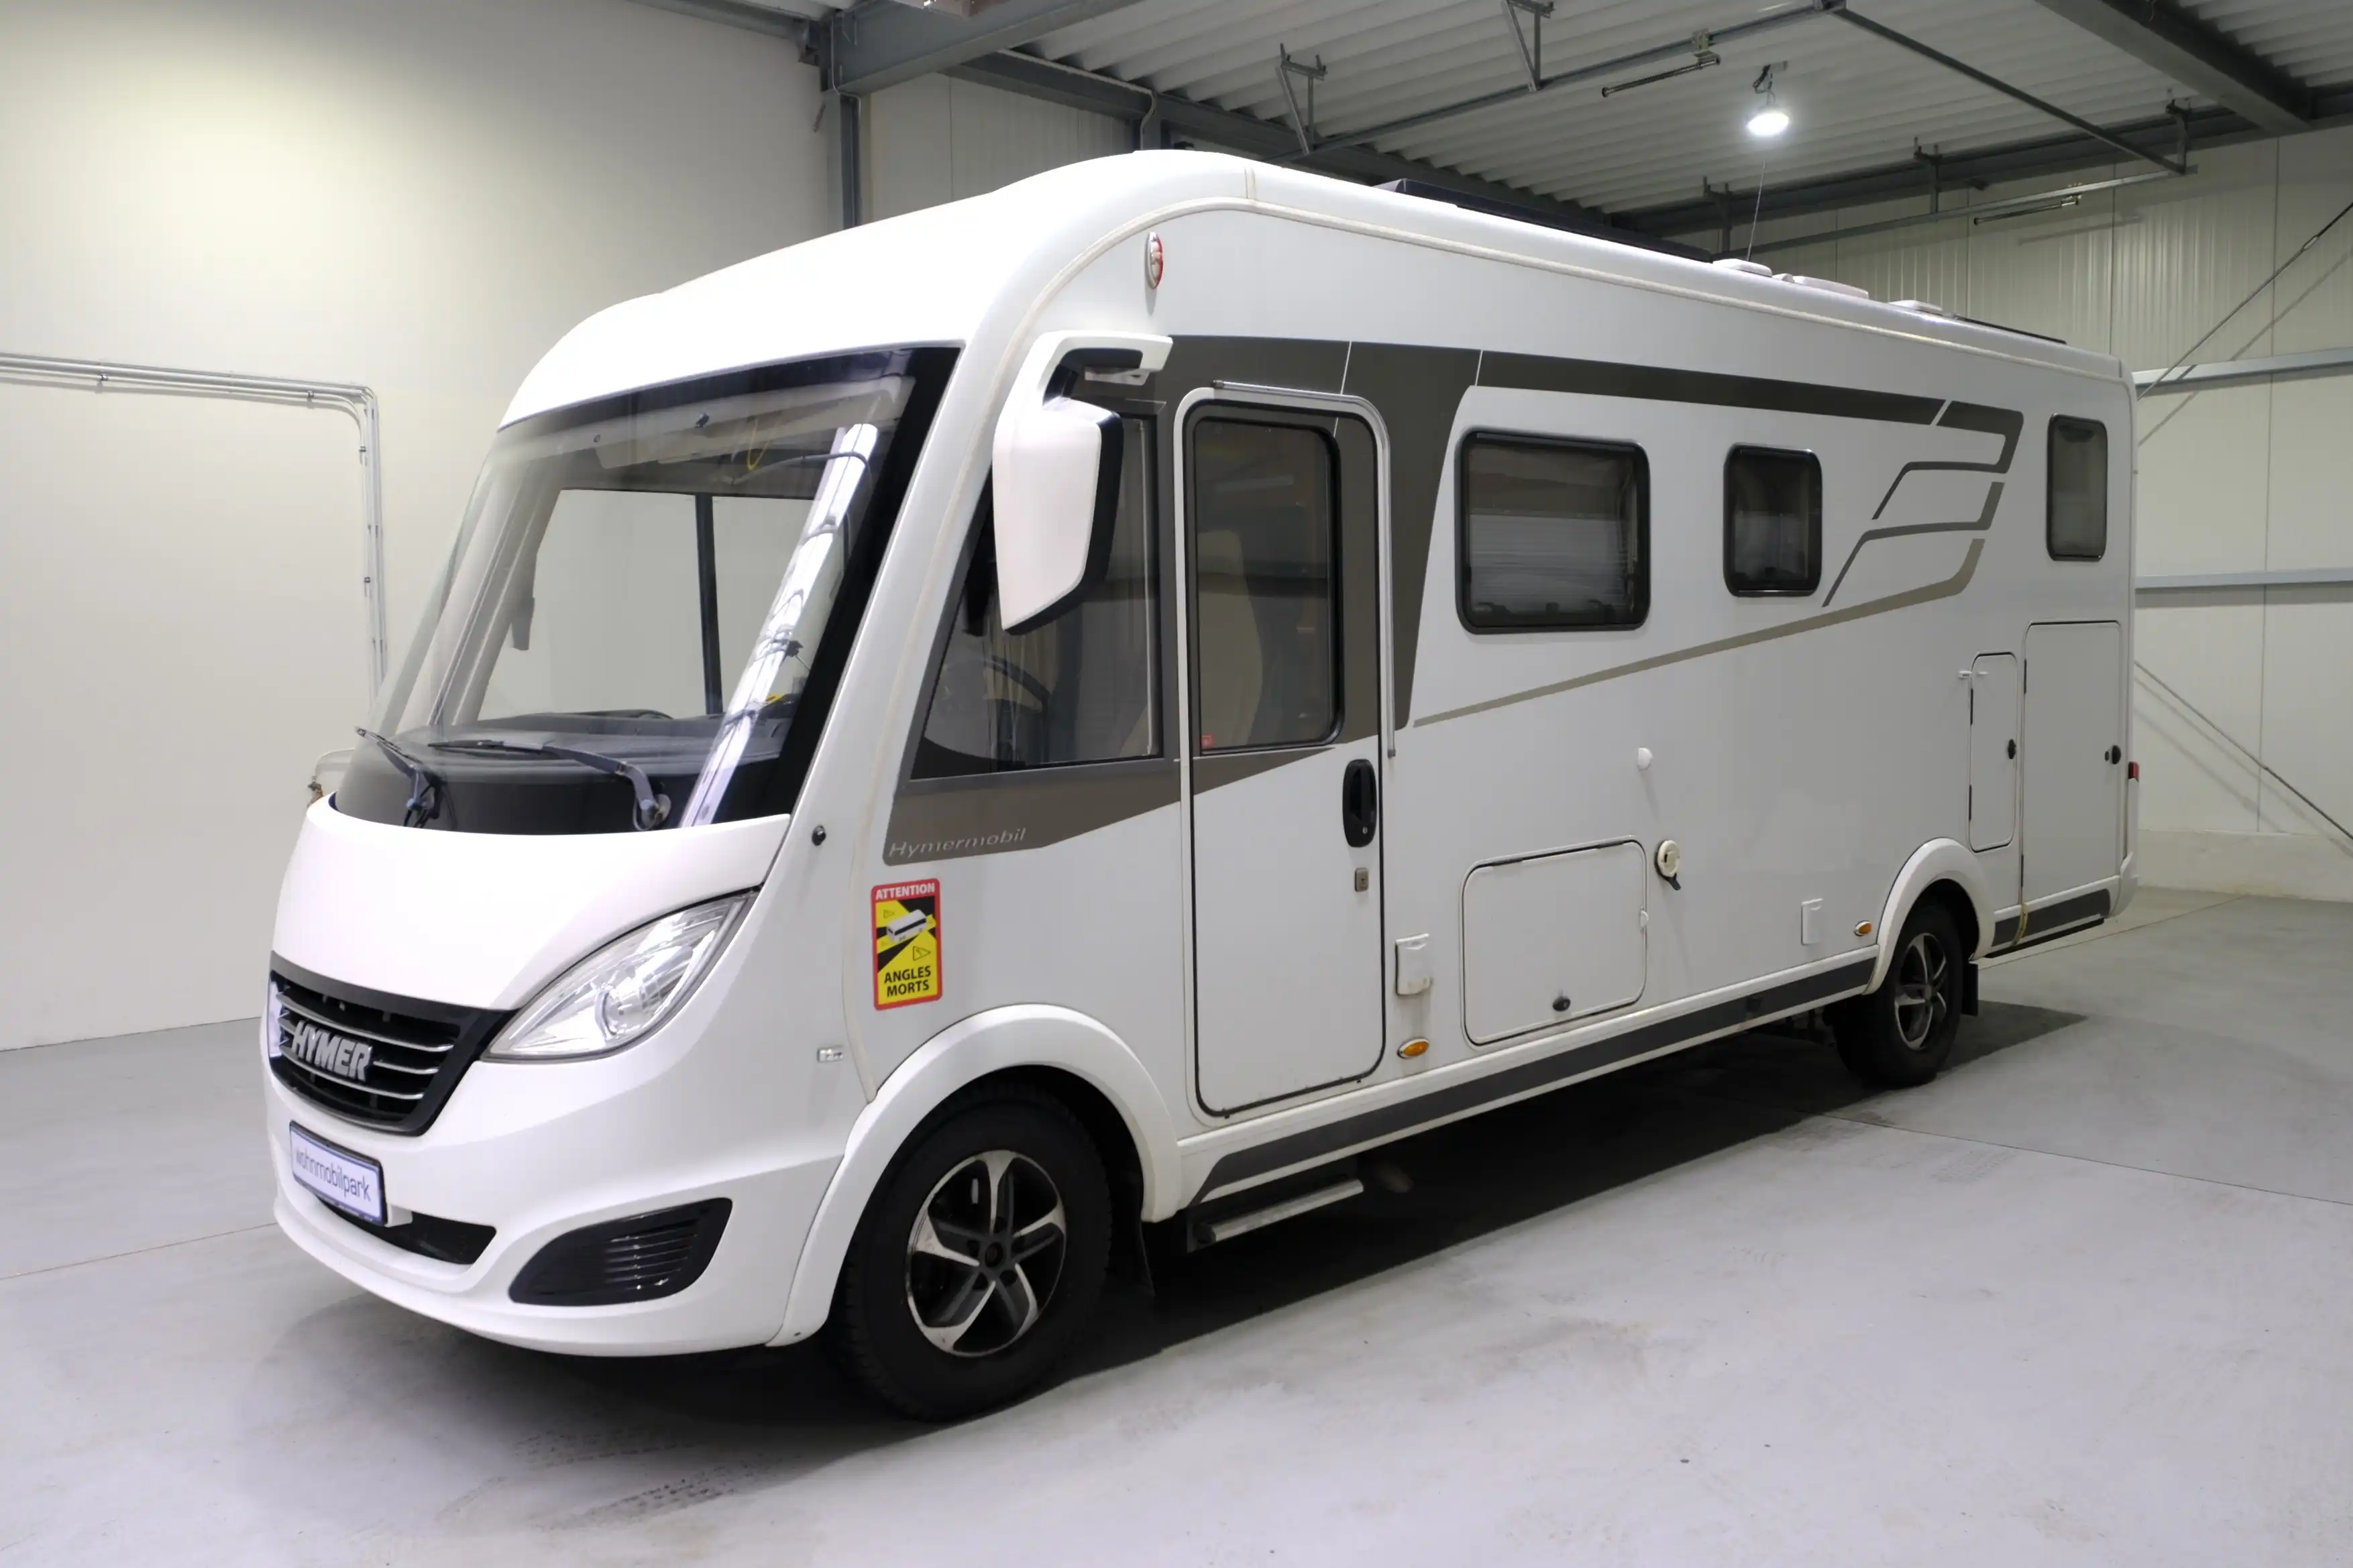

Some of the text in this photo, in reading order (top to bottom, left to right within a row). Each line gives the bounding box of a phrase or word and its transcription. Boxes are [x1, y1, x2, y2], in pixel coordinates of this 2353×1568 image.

[889, 828, 1026, 858] Hymermobil
[875, 882, 936, 901] ATTENTION
[884, 965, 932, 985] ANGLES
[886, 980, 930, 998] MORTS
[292, 1020, 373, 1082] HYMER
[296, 1148, 371, 1201] wohnmobilpark
